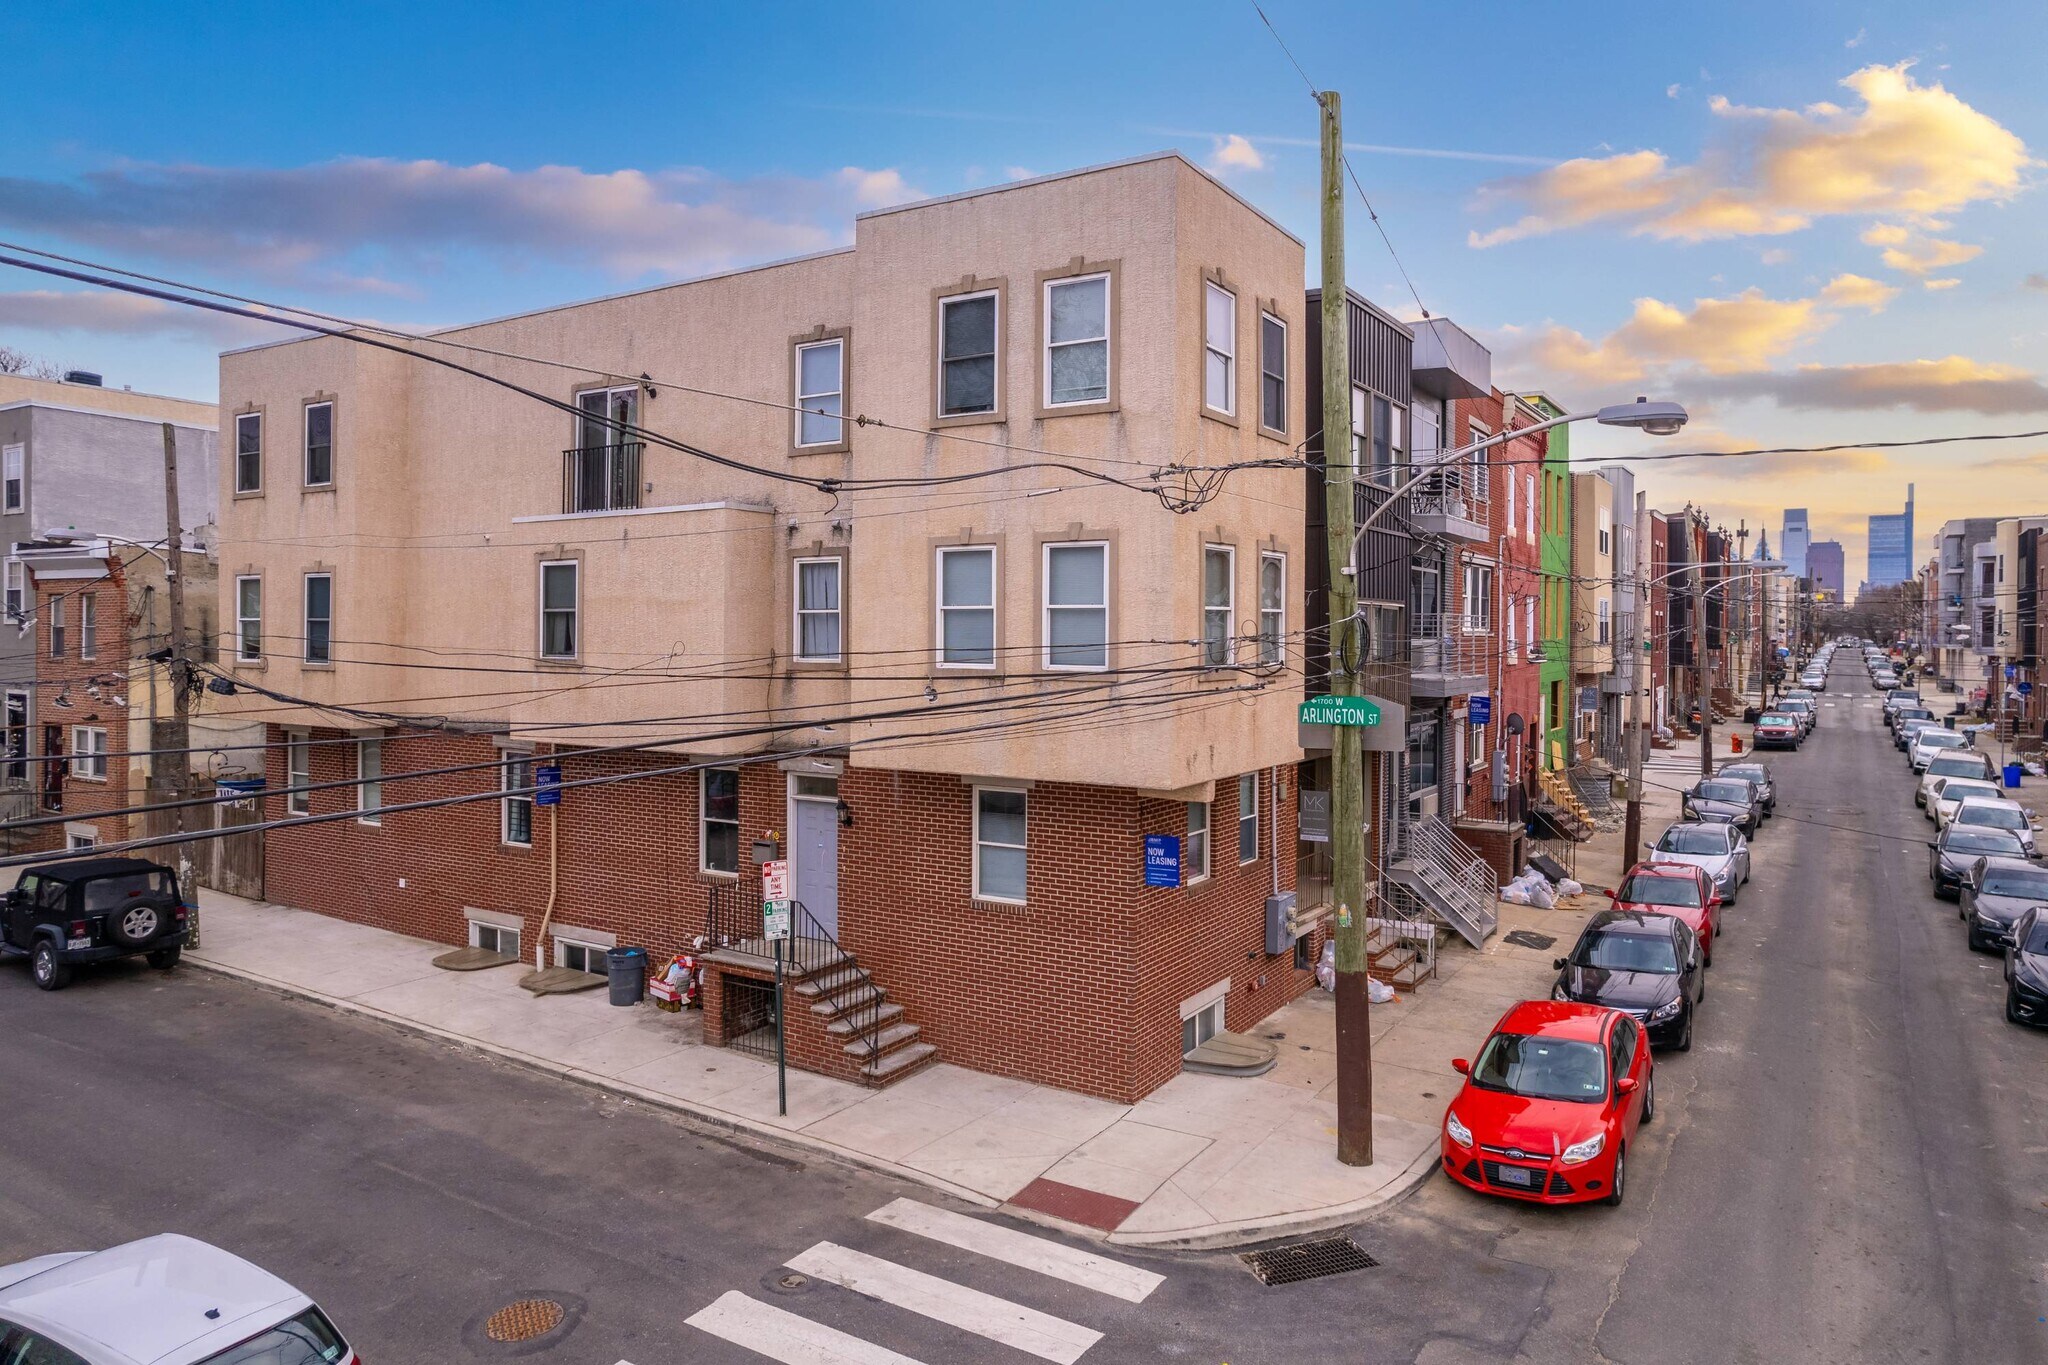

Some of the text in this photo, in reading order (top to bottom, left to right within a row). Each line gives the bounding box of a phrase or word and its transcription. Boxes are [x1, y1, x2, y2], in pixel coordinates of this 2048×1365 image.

[1335, 698, 1344, 706] W
[1302, 707, 1378, 725] ARLINGTON ST
[1303, 795, 1325, 810] MK
[1147, 847, 1165, 857] NOW
[1147, 856, 1177, 867] LEASING
[770, 883, 782, 891] TIME
[766, 904, 771, 914] 2
